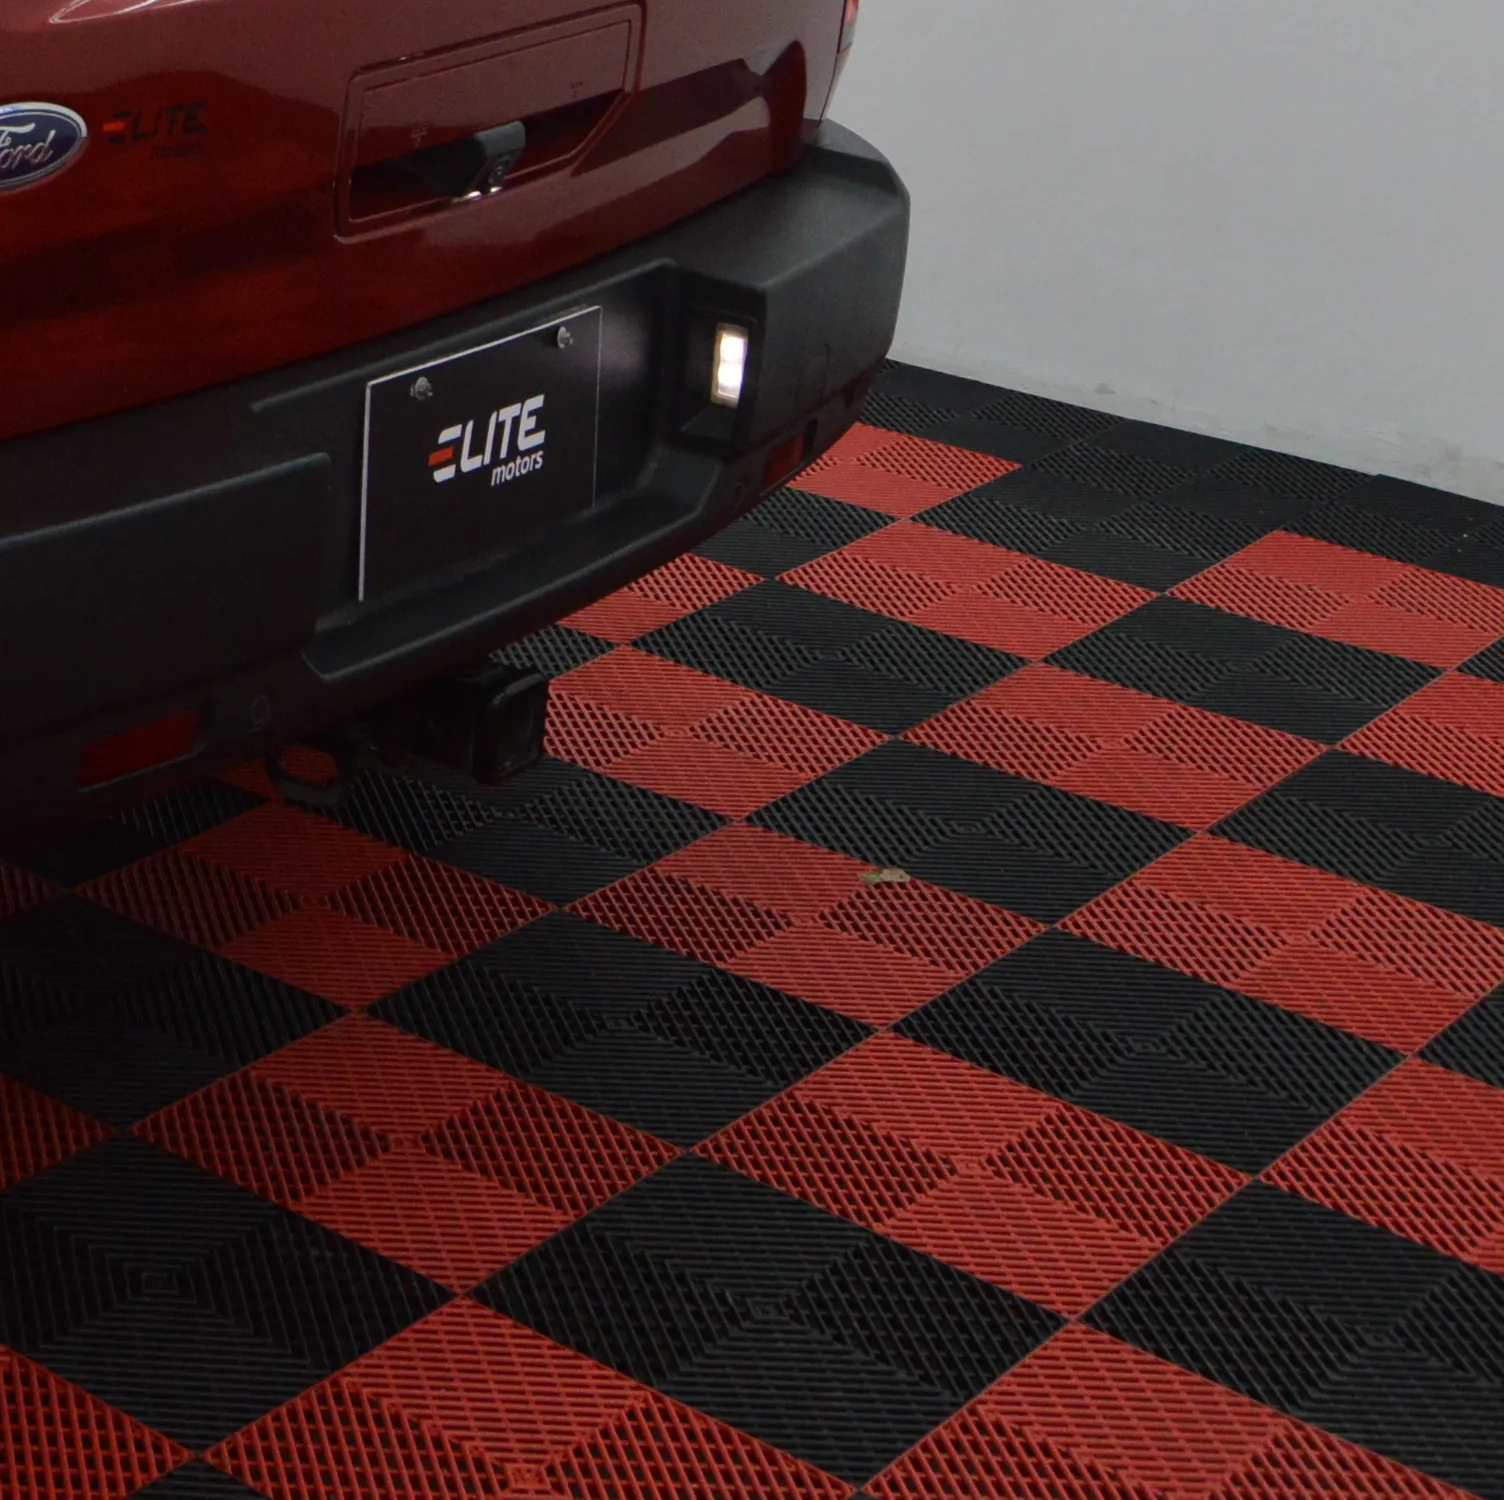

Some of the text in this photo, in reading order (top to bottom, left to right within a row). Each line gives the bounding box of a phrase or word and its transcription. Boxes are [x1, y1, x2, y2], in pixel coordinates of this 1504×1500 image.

[102, 102, 208, 144] ELITE
[428, 394, 546, 484] ELITE
[490, 450, 545, 487] motors
